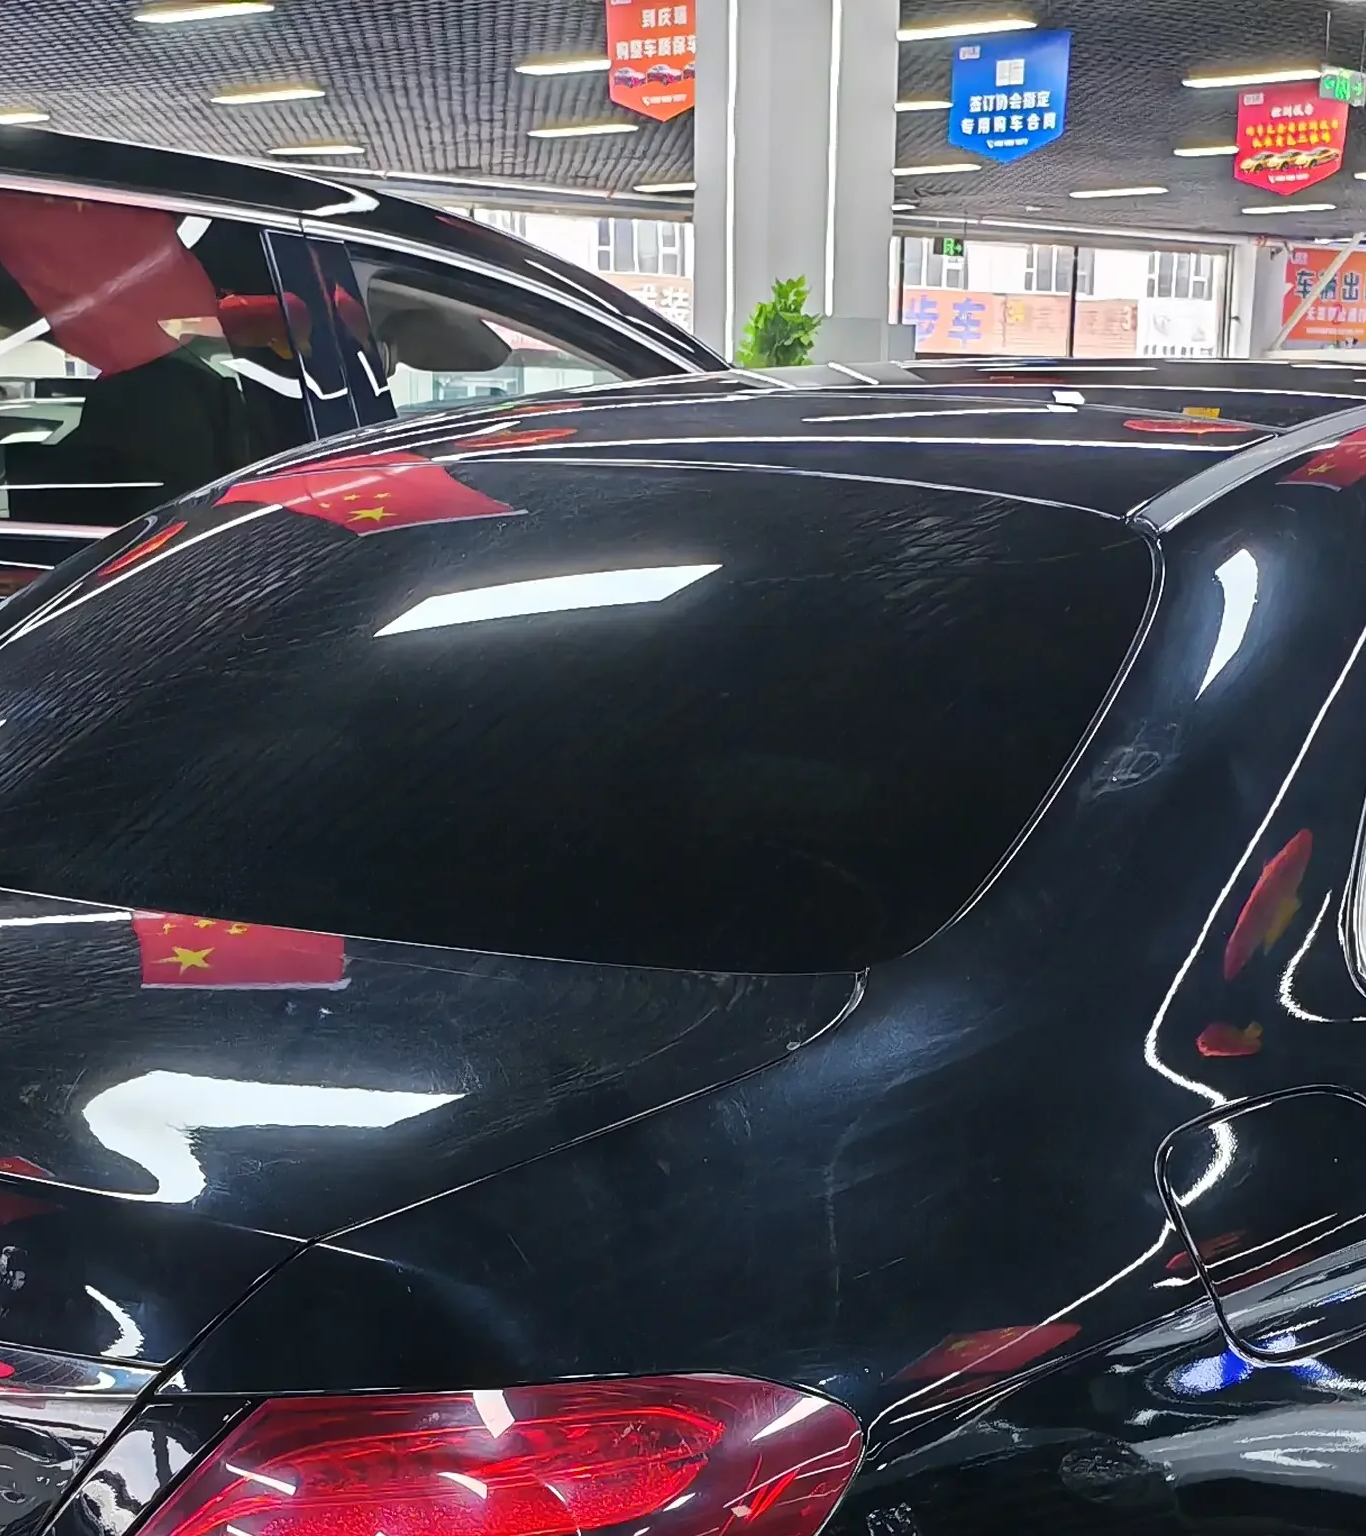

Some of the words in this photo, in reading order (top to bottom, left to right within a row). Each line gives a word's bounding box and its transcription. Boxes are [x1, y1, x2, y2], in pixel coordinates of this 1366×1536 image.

[969, 91, 1051, 113] 签订协会指定
[960, 112, 1057, 135] 专用购车合同
